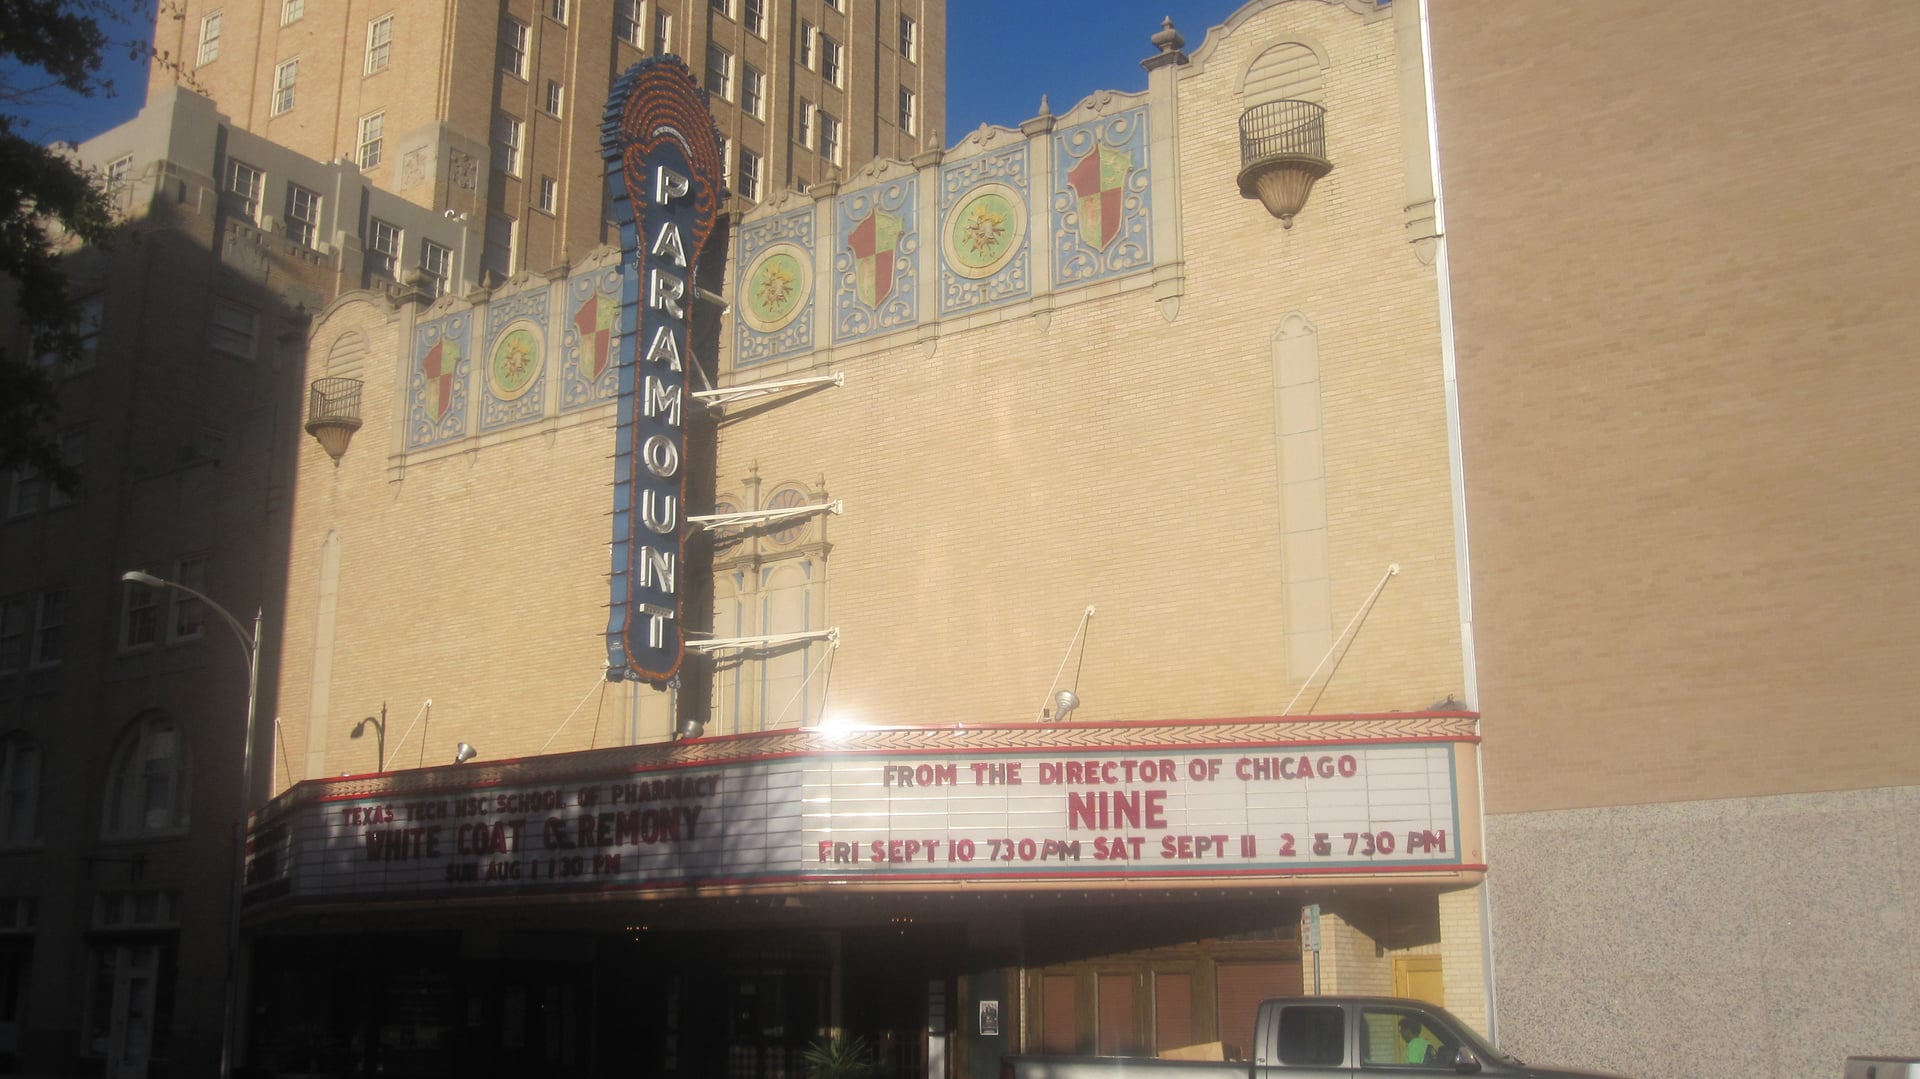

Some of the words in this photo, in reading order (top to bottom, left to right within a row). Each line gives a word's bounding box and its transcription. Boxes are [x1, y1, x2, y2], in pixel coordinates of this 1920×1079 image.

[640, 165, 690, 648] PARAMOUNT
[884, 765, 957, 788] FROM
[971, 762, 1022, 786] THE
[1039, 760, 1177, 785] DIRECTOR
[1189, 759, 1223, 782] OF
[1236, 755, 1357, 782] CHICAGO
[342, 805, 394, 827] TEXAS
[405, 801, 447, 821] TECH
[455, 797, 488, 817] HSC
[577, 787, 601, 808] OF
[611, 776, 720, 805] PHARMACY
[1069, 790, 1167, 831] NINE
[366, 826, 442, 862] WHITE
[457, 818, 526, 855] COAT
[819, 841, 858, 864] FRI
[871, 840, 939, 863] SEPT
[987, 838, 1037, 862] 730
[1041, 839, 1081, 860] PM
[1093, 836, 1145, 860] SAT
[1161, 834, 1228, 859] SEPT
[1279, 833, 1297, 857] 2
[1314, 834, 1331, 856] &
[1344, 832, 1395, 856] 730
[1407, 830, 1446, 853] PM
[445, 863, 481, 883] SUN
[486, 862, 520, 881] AUG
[593, 854, 621, 875] PM
